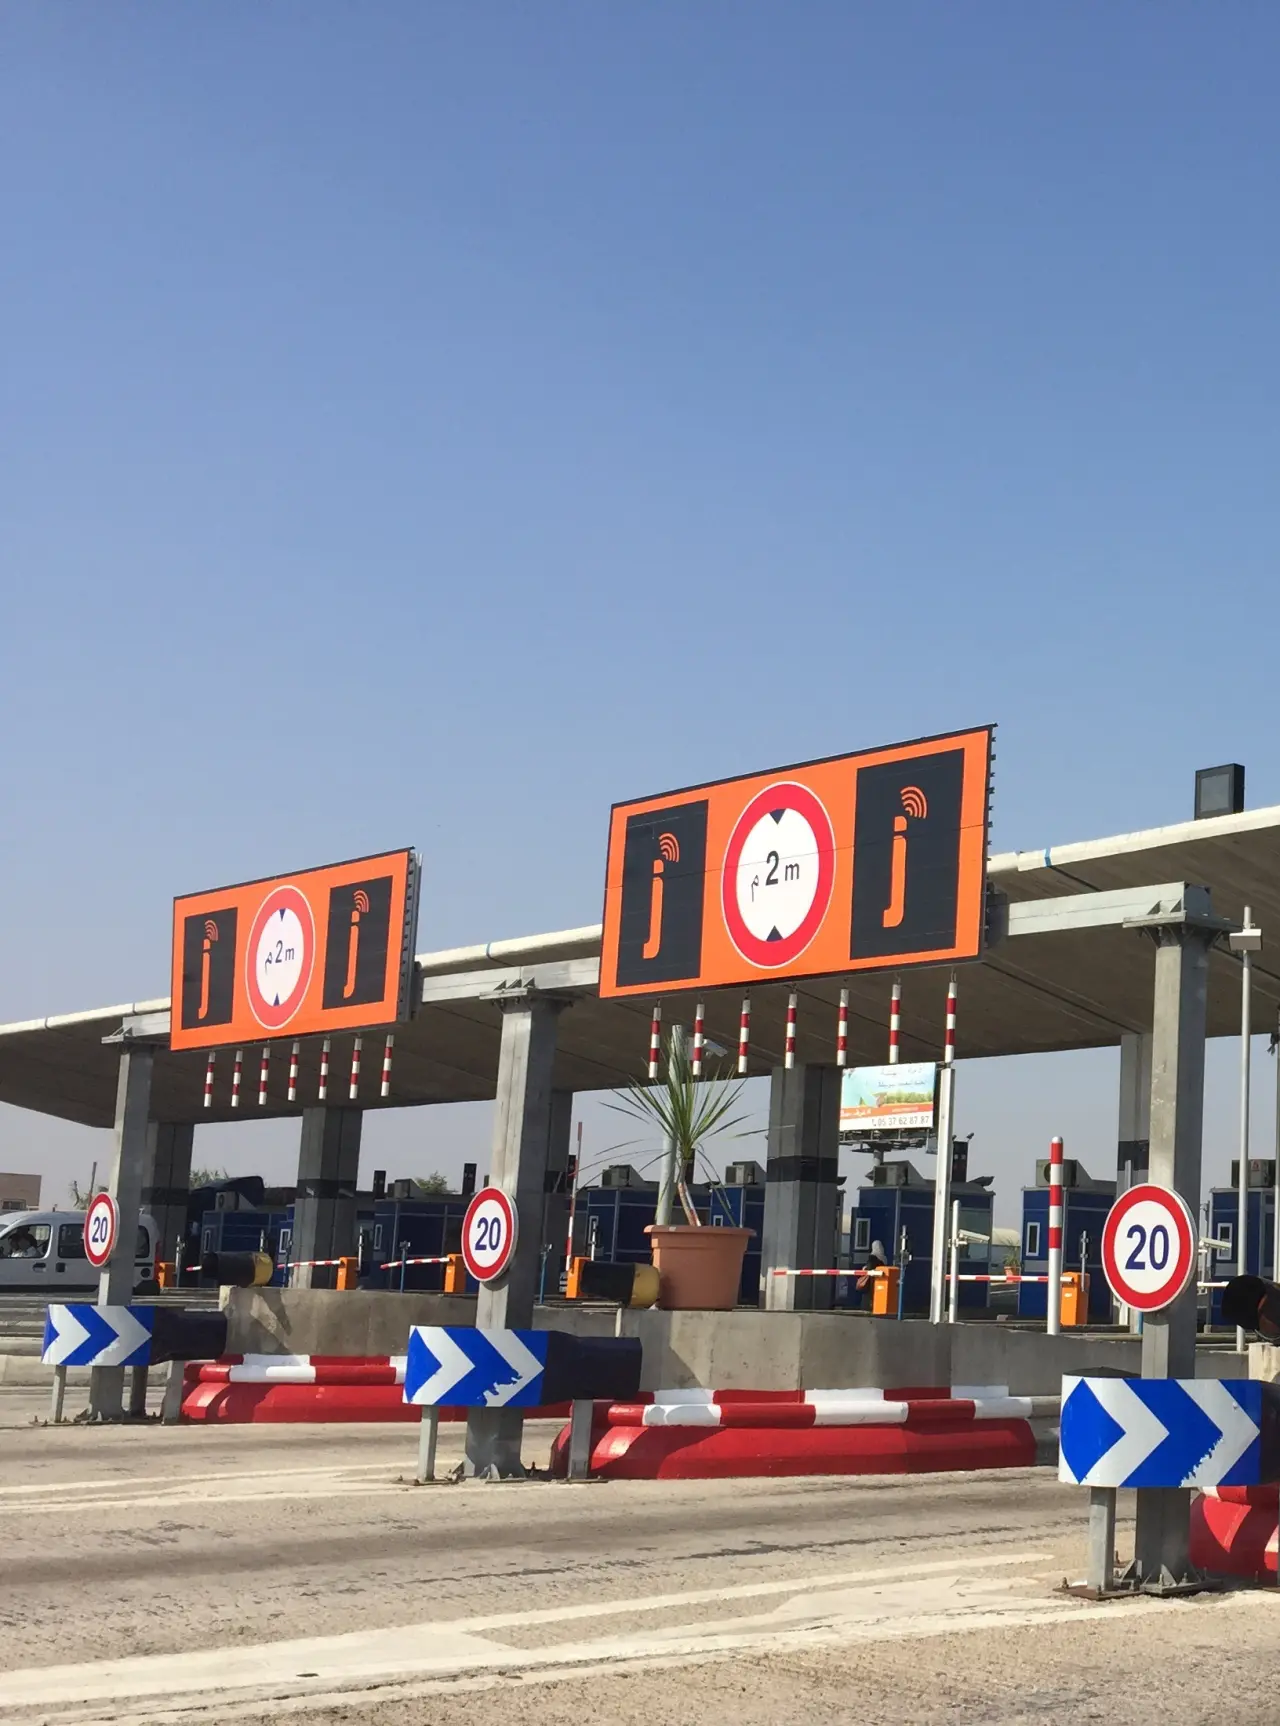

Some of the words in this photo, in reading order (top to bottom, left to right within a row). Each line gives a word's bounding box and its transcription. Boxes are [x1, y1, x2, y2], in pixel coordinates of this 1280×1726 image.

[765, 850, 780, 886] 2
[784, 862, 800, 882] m
[275, 939, 283, 964] 2
[285, 947, 295, 961] m
[92, 1216, 108, 1243] 20
[474, 1216, 501, 1251] 20
[1125, 1224, 1170, 1271] 20
